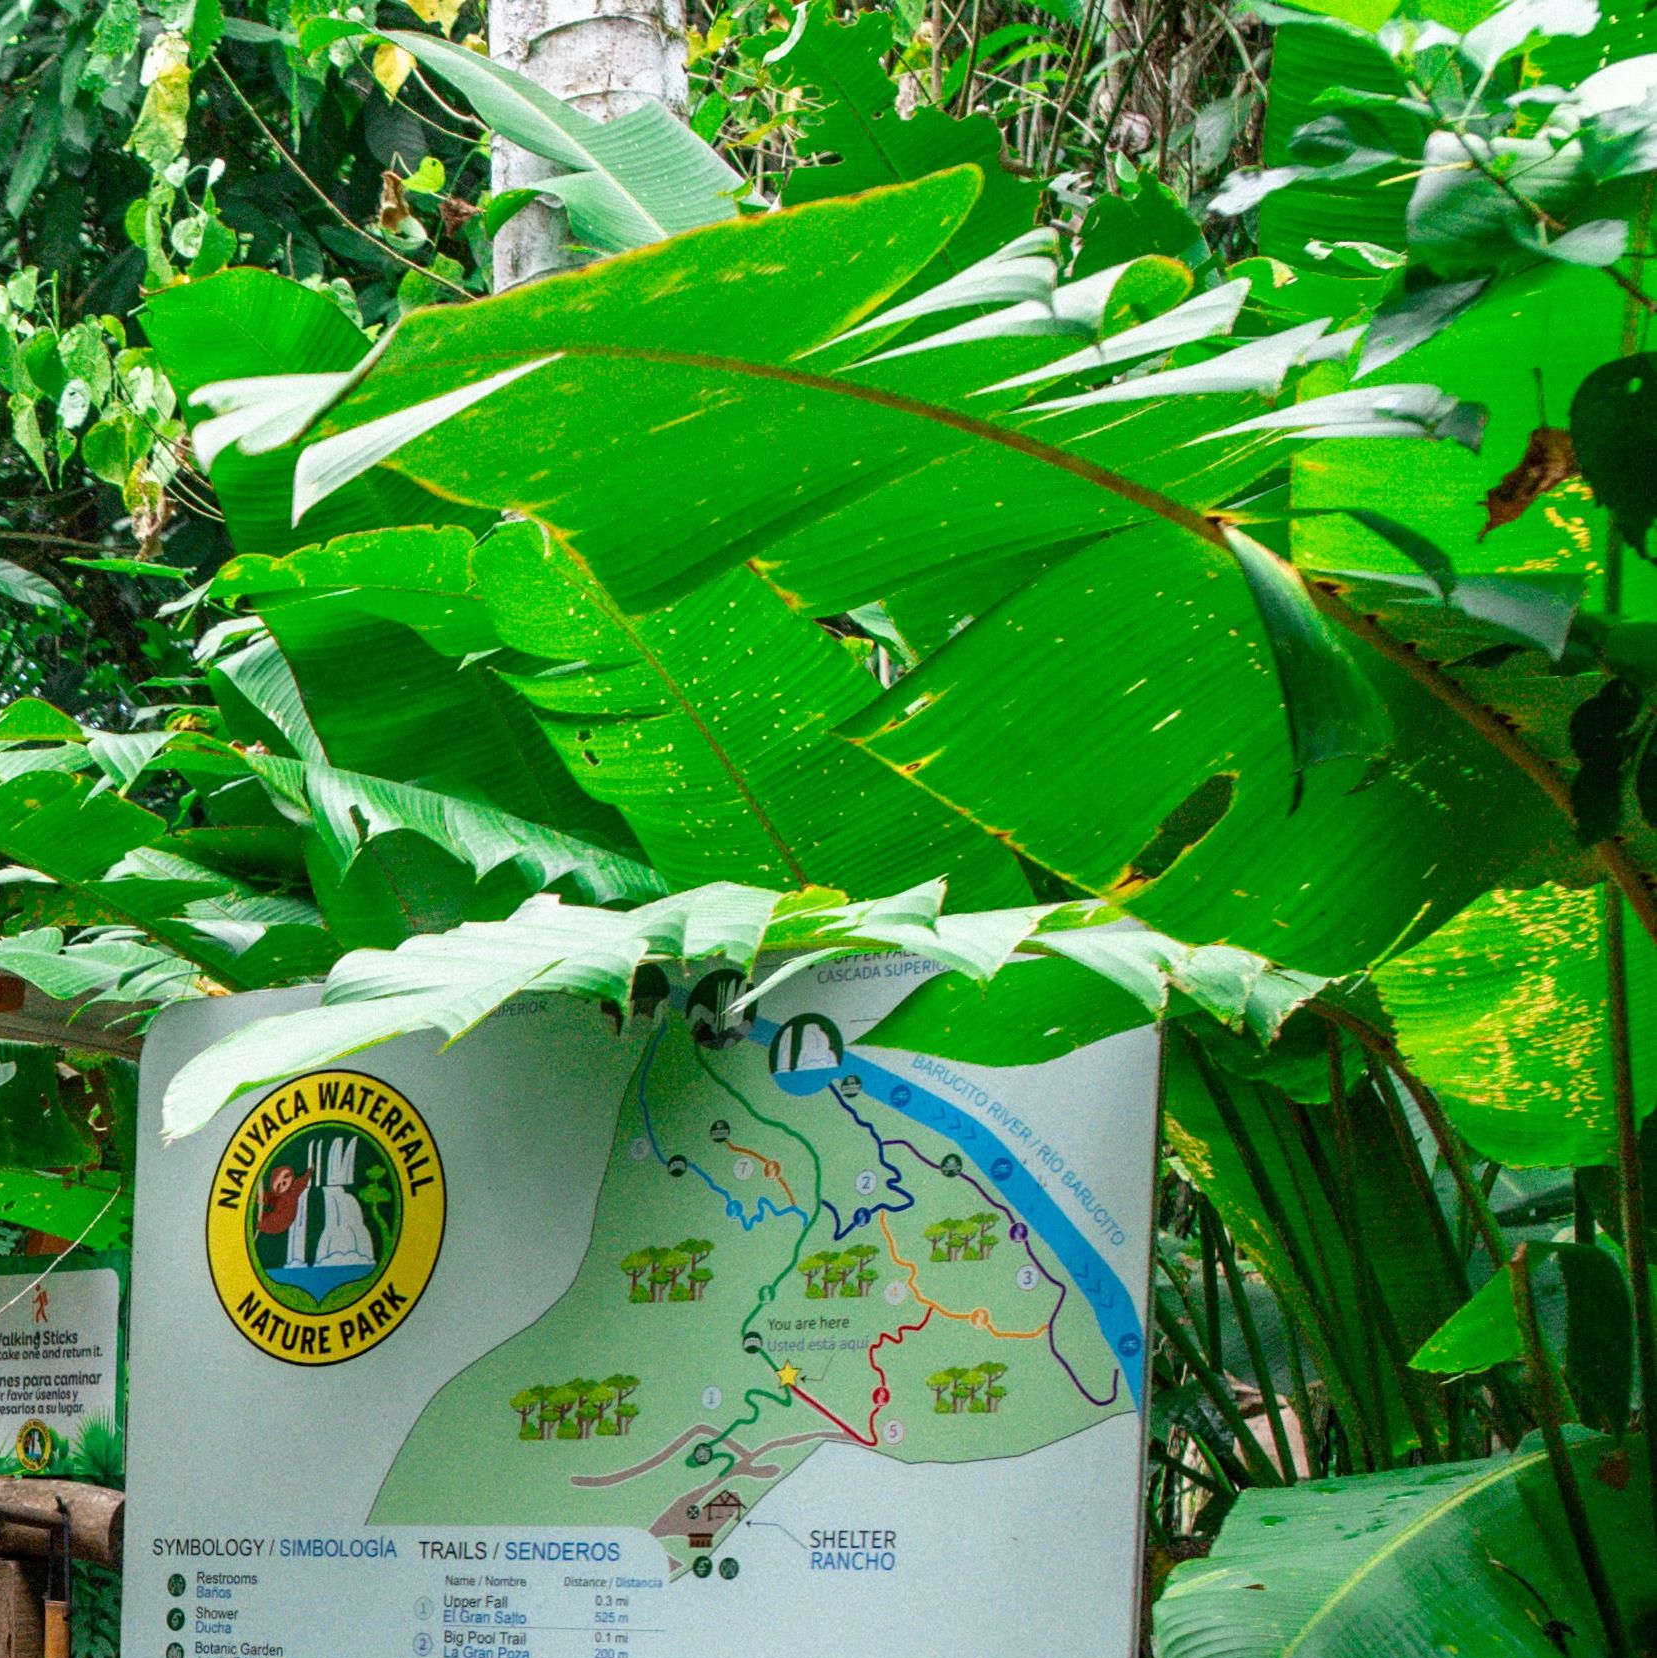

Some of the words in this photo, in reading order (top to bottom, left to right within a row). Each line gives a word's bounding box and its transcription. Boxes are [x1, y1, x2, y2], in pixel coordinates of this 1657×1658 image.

[885, 960, 951, 977] SUPERIO
[218, 1090, 309, 1210] NAUYACA
[318, 1081, 434, 1197] WATERFALL
[912, 1055, 989, 1107] BARUCITO
[988, 1101, 1033, 1146] RIVER
[1036, 1143, 1065, 1175] RÍO
[1061, 1164, 1126, 1247] BARUCITO
[741, 1162, 748, 1174] 7
[861, 1175, 871, 1189] 2
[1023, 1271, 1032, 1284] 3
[237, 1291, 331, 1353] NATURE
[340, 1282, 408, 1348] PARK
[768, 1318, 791, 1330] You
[795, 1318, 816, 1329] are
[820, 1316, 849, 1329] here
[43, 1331, 77, 1343] Sticks
[768, 1338, 805, 1352] Usted
[808, 1338, 836, 1350] está
[839, 1336, 869, 1350] aquí
[22, 1350, 39, 1359] one
[42, 1348, 60, 1358] and
[62, 1347, 91, 1358] return
[93, 1347, 102, 1356] it.
[23, 1375, 52, 1389] para
[54, 1371, 101, 1385] caminar
[7, 1389, 32, 1400] favor
[72, 1391, 78, 1402] y
[38, 1405, 44, 1414] a
[46, 1404, 57, 1414] su
[889, 1425, 897, 1438] 5
[810, 1530, 896, 1549] SHELTER
[153, 1539, 265, 1556] SYMBOLOGY
[280, 1536, 397, 1558] SIMBOLOGÍA
[419, 1541, 487, 1560] TRAILS
[505, 1542, 620, 1561] SENDEROS
[810, 1551, 895, 1571] RANCHO
[197, 1572, 258, 1585] Restrooms
[445, 1576, 475, 1586] Name
[485, 1577, 526, 1587] Nombre
[564, 1577, 606, 1588] Distance
[197, 1586, 232, 1599] Baños
[444, 1595, 481, 1611] Upper
[486, 1596, 508, 1609] Fall
[595, 1595, 611, 1607] 0.3
[616, 1596, 628, 1607] mi
[196, 1607, 238, 1620] Shower
[444, 1611, 455, 1623] El
[460, 1611, 490, 1624] Gran
[495, 1612, 526, 1625] Salto
[595, 1612, 615, 1623] 525
[619, 1615, 628, 1623] m
[196, 1621, 232, 1634] Ducha
[444, 1631, 463, 1646] Big
[467, 1633, 495, 1645] Pool
[501, 1633, 526, 1645] Trail
[195, 1642, 237, 1655] Botanic
[241, 1643, 283, 1656] Garden
